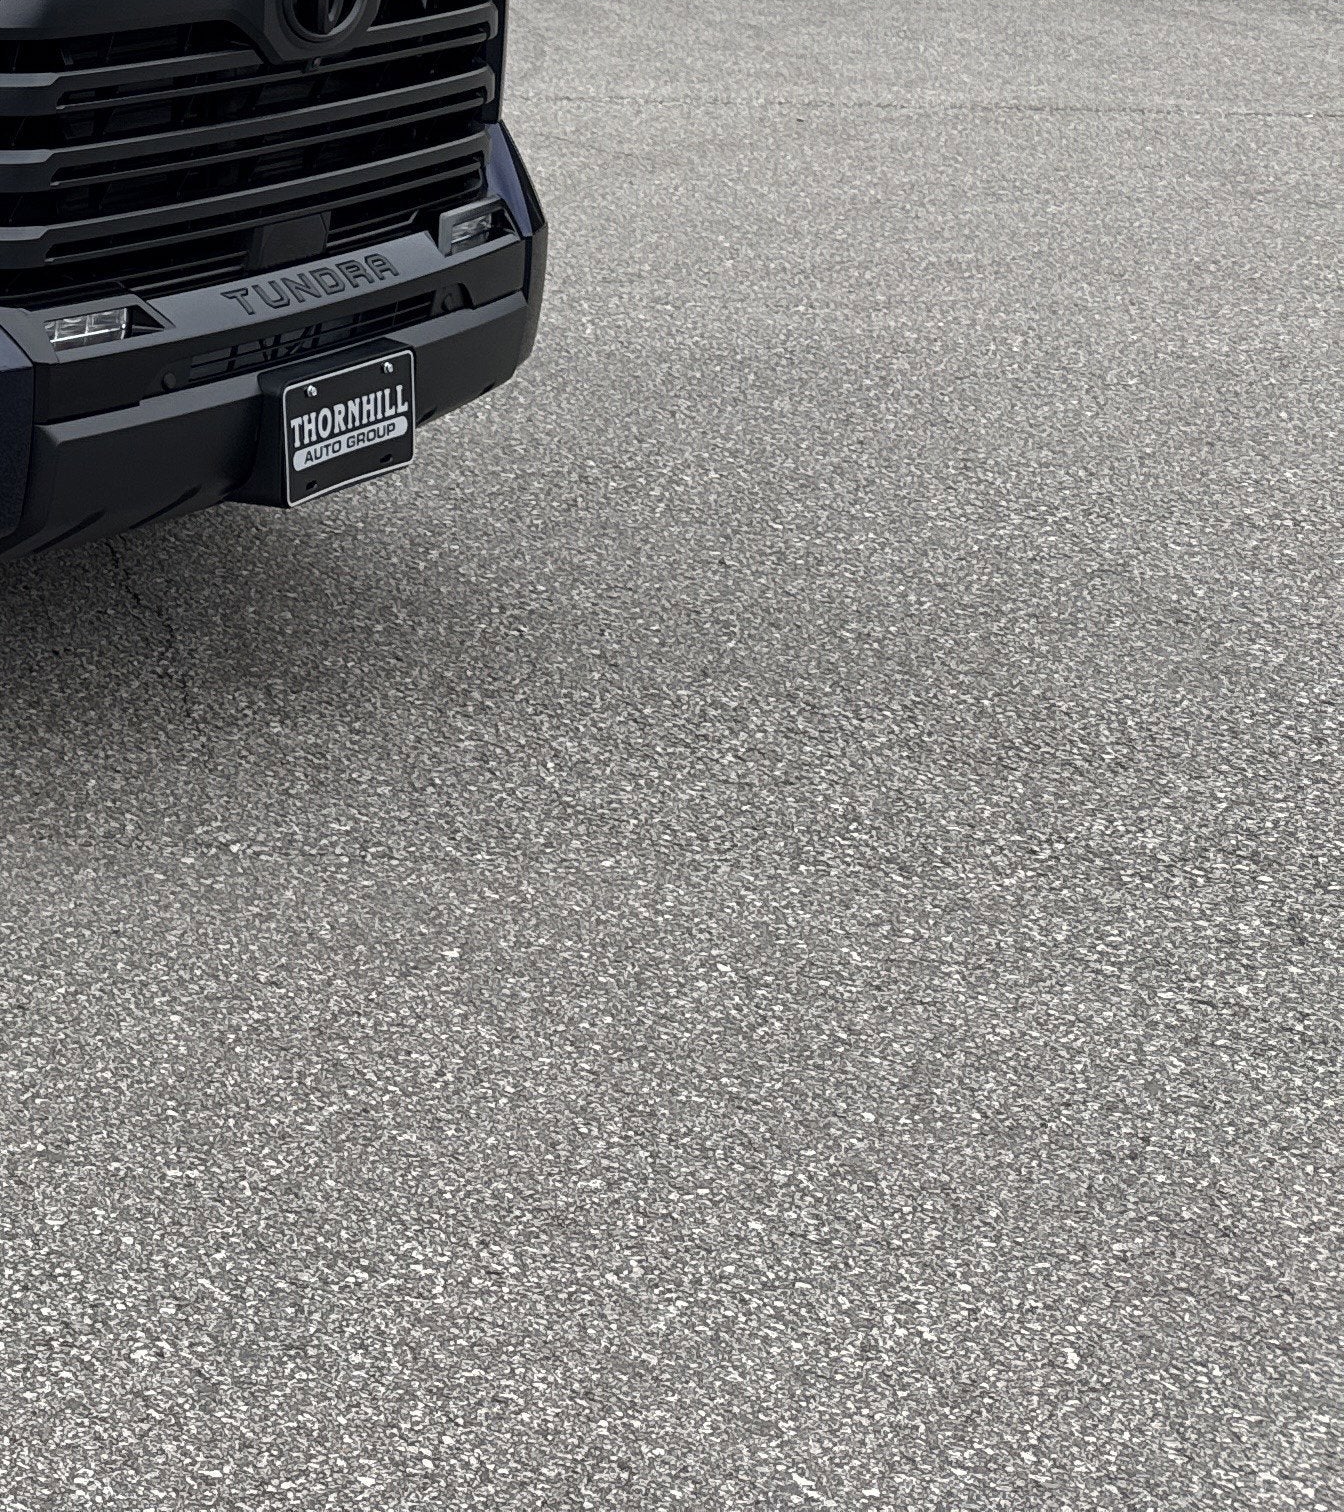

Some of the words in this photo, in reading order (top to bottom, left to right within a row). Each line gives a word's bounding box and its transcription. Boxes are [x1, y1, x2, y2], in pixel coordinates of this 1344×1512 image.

[220, 253, 399, 316] TUNDRA
[290, 385, 408, 448] THORNHILL
[304, 440, 342, 465] AUTO
[346, 422, 396, 449] GROUP
